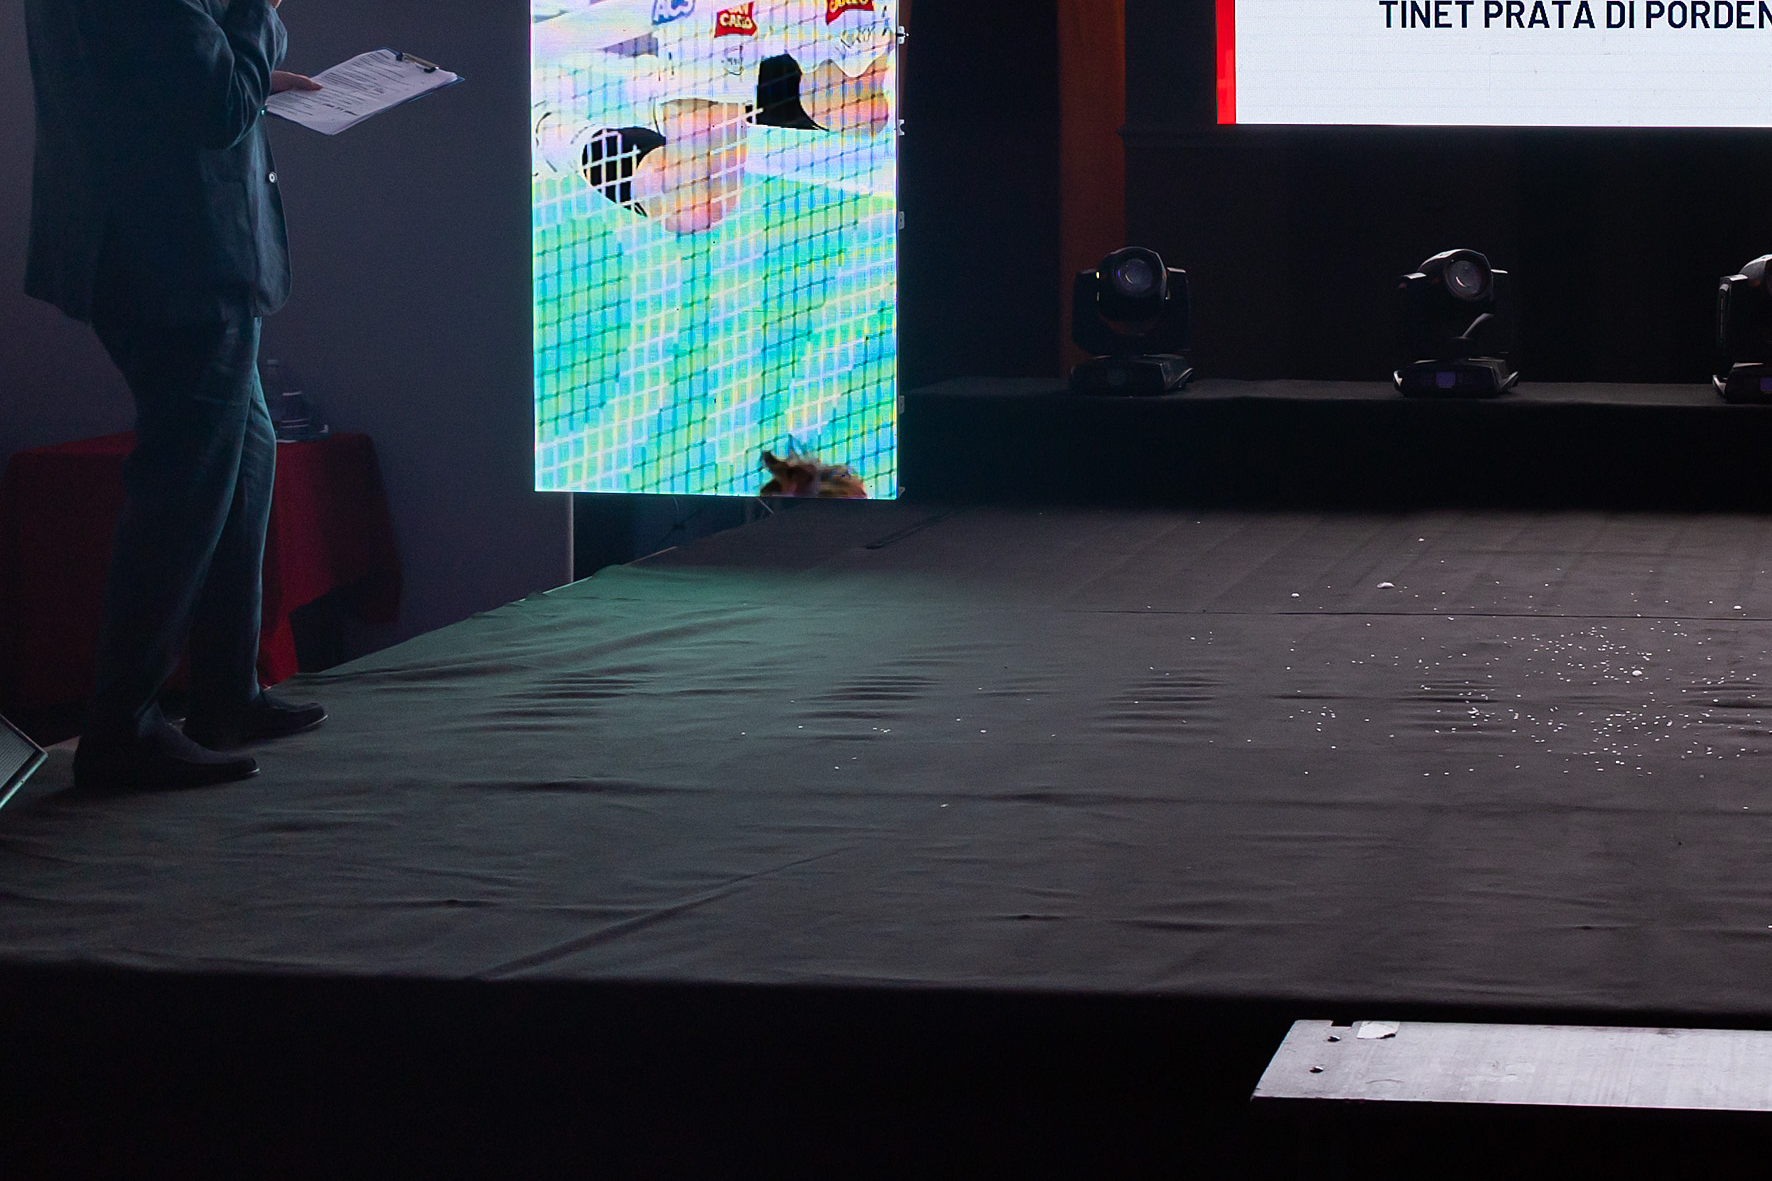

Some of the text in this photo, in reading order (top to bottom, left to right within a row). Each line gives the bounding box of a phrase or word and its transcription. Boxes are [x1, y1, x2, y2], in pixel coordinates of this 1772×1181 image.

[1379, 0, 1474, 28] TINET
[1484, 1, 1595, 28] PRATA
[1607, 1, 1634, 28] DI
